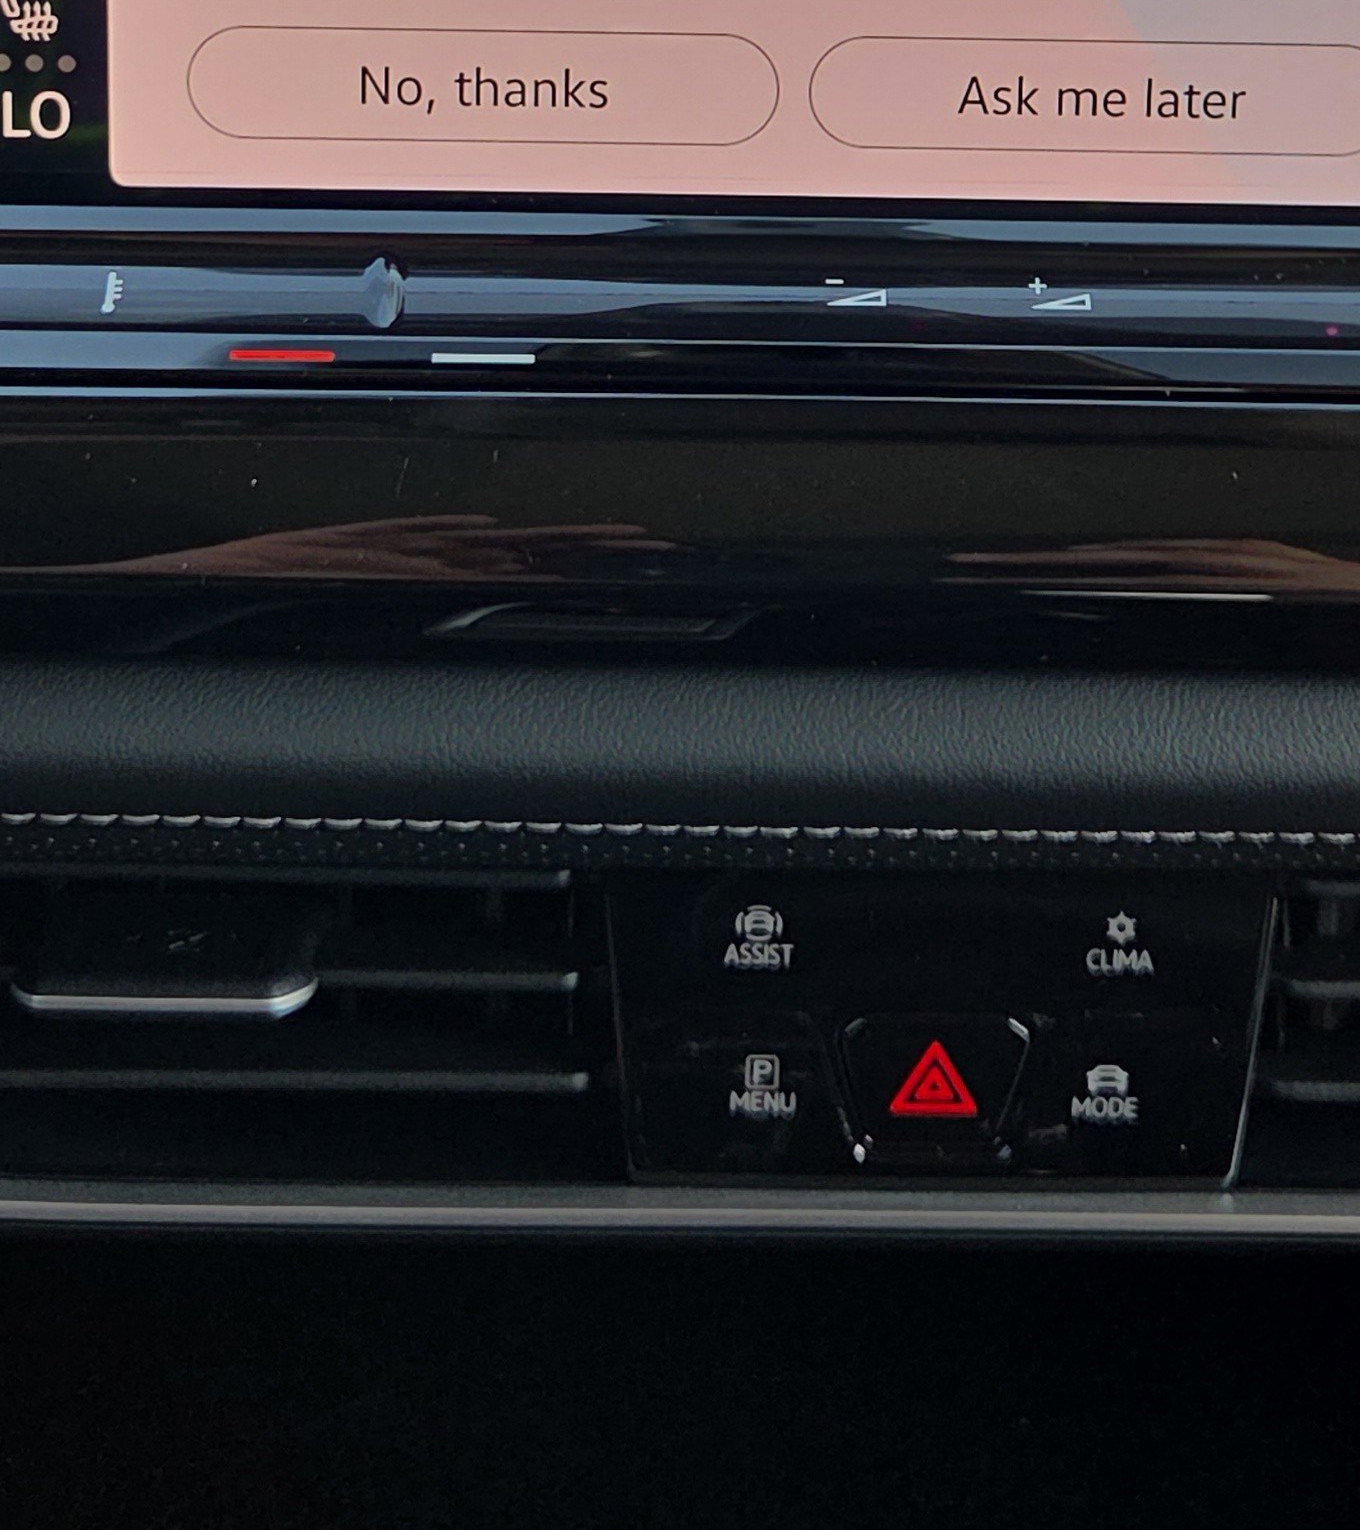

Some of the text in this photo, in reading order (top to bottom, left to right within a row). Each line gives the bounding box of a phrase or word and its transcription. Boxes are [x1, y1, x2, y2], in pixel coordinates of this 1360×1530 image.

[361, 66, 608, 115] No, thanks
[957, 76, 1246, 120] Ask me later
[2, 90, 71, 140] LO
[724, 943, 794, 966] ASSIST
[1086, 948, 1153, 973] CLIMA
[729, 1090, 797, 1116] MENU
[1070, 1095, 1138, 1119] MODE
